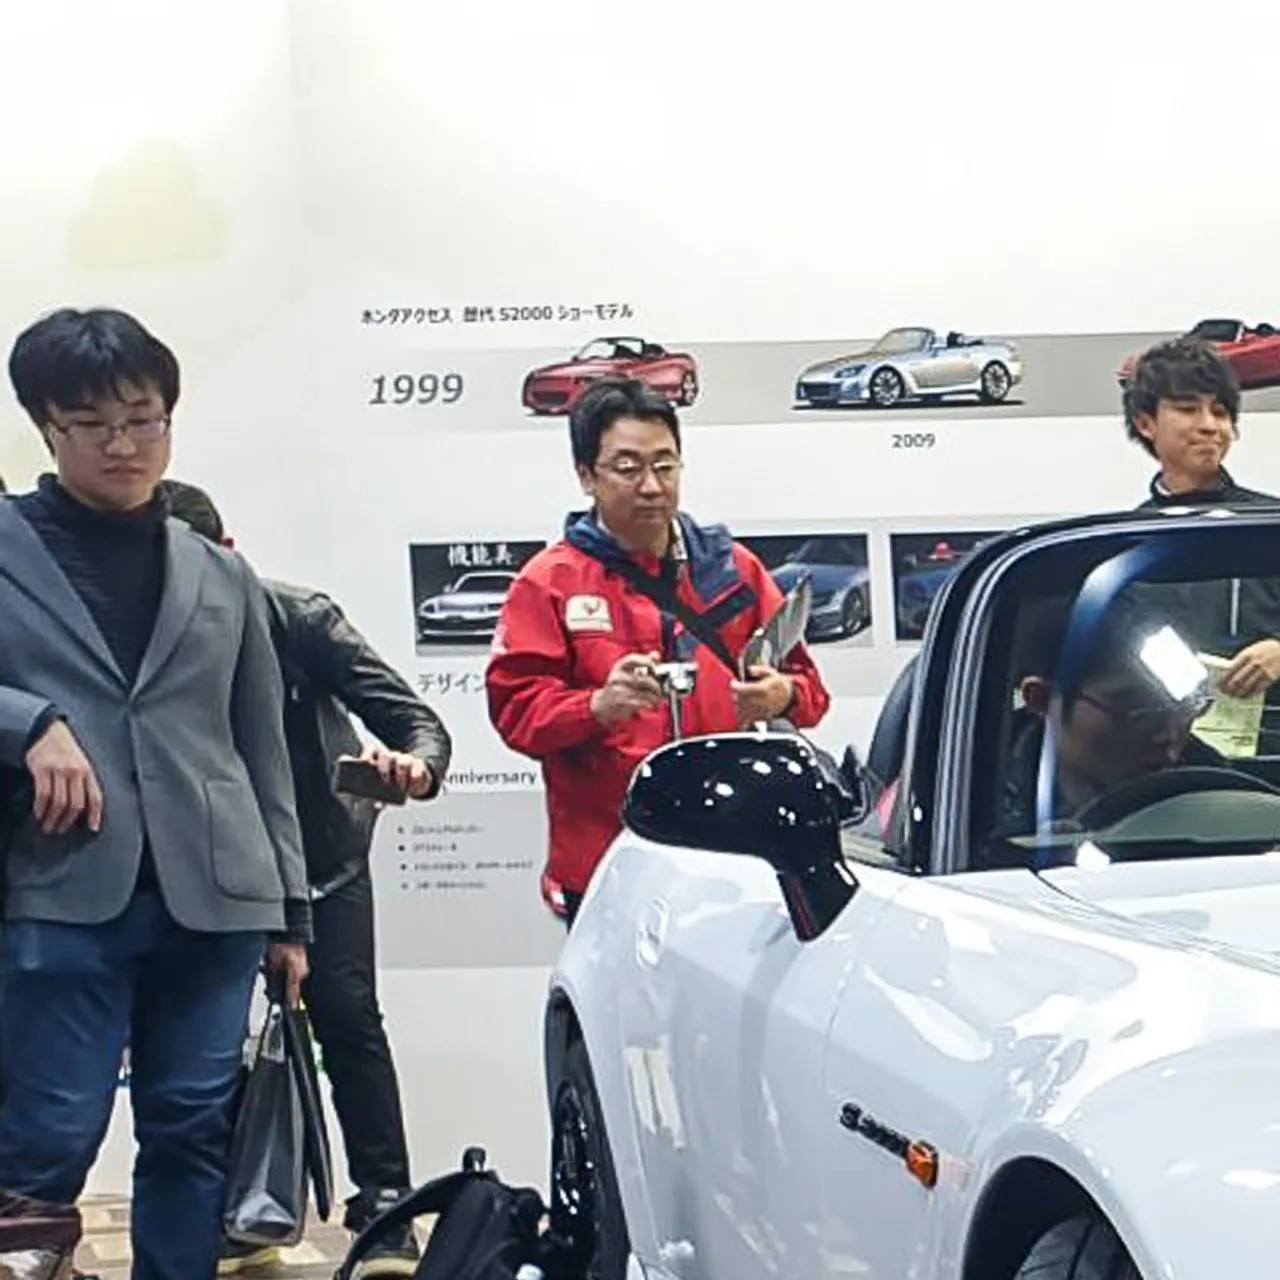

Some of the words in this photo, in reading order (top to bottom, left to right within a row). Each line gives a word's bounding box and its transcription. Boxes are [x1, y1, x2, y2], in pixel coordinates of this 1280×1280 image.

[369, 373, 464, 405] 1999
[891, 432, 936, 448] 2009
[447, 768, 537, 786] nniversary
